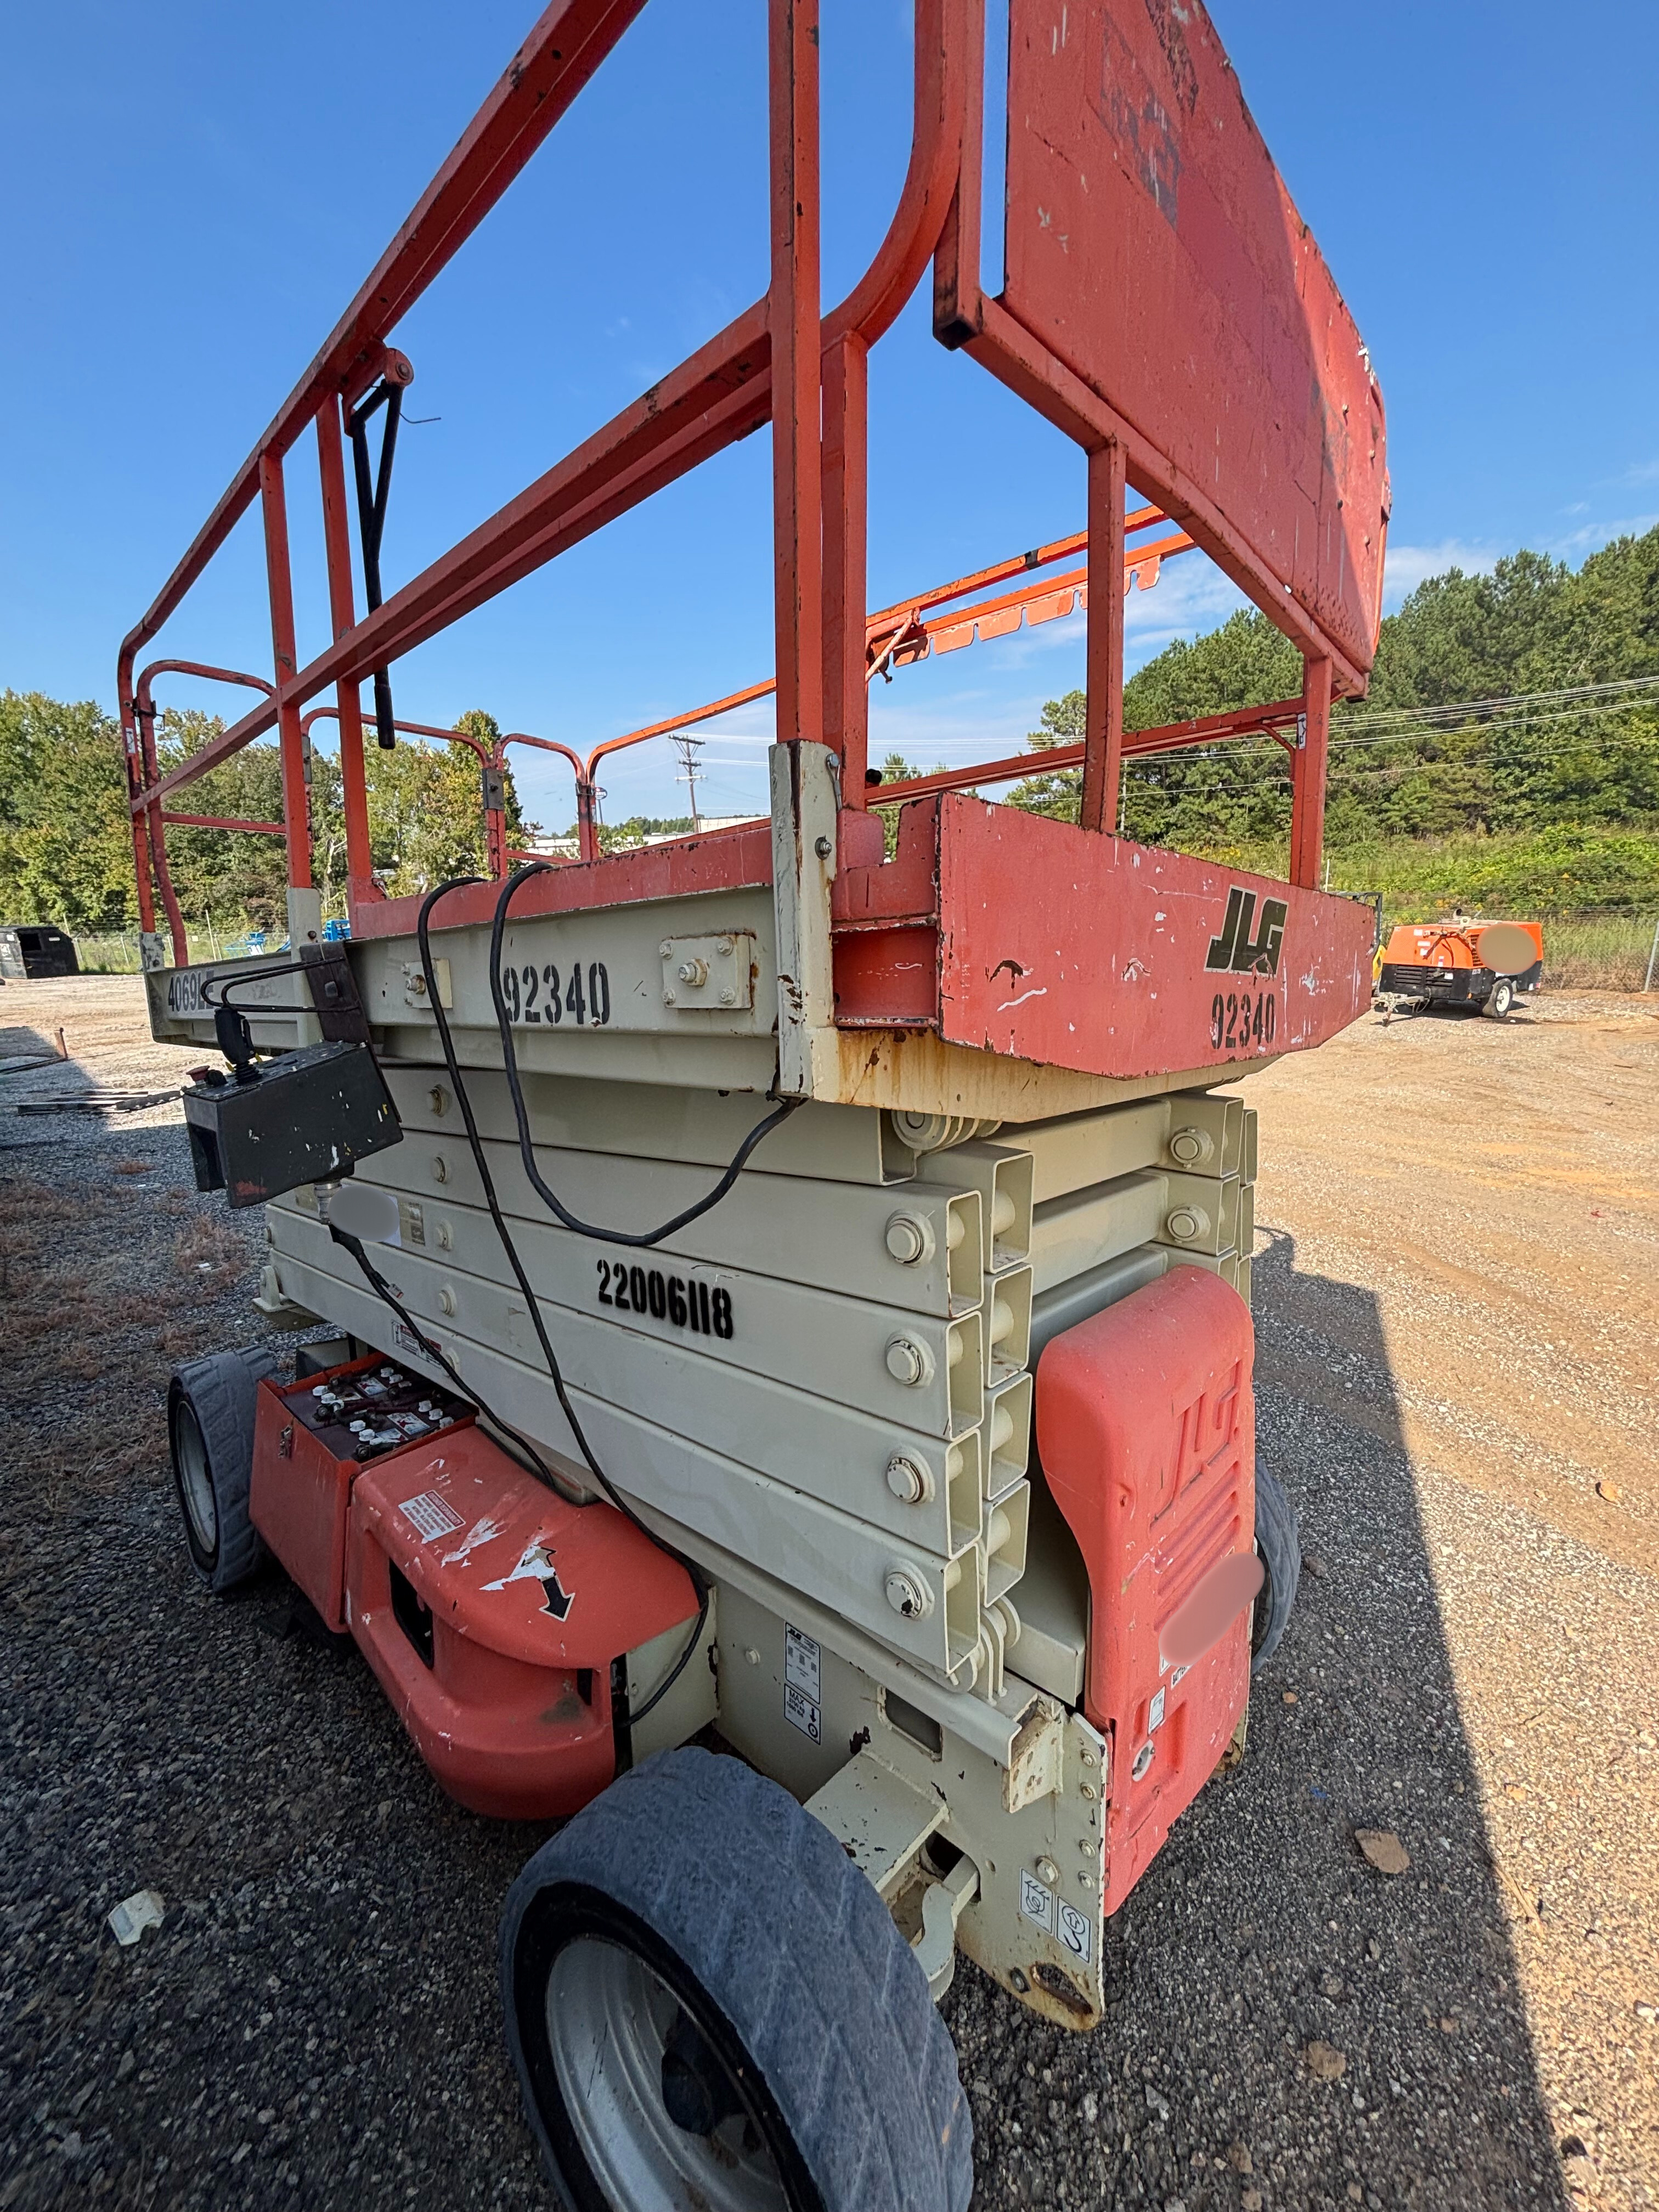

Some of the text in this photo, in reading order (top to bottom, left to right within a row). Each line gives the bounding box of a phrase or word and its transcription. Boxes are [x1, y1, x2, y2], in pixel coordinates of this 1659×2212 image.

[1204, 884, 1289, 978] JLG
[168, 969, 214, 1012] 4069LE
[504, 962, 610, 1025] 92340
[597, 1259, 733, 1340] 22006118
[789, 1689, 805, 1708] MAX
